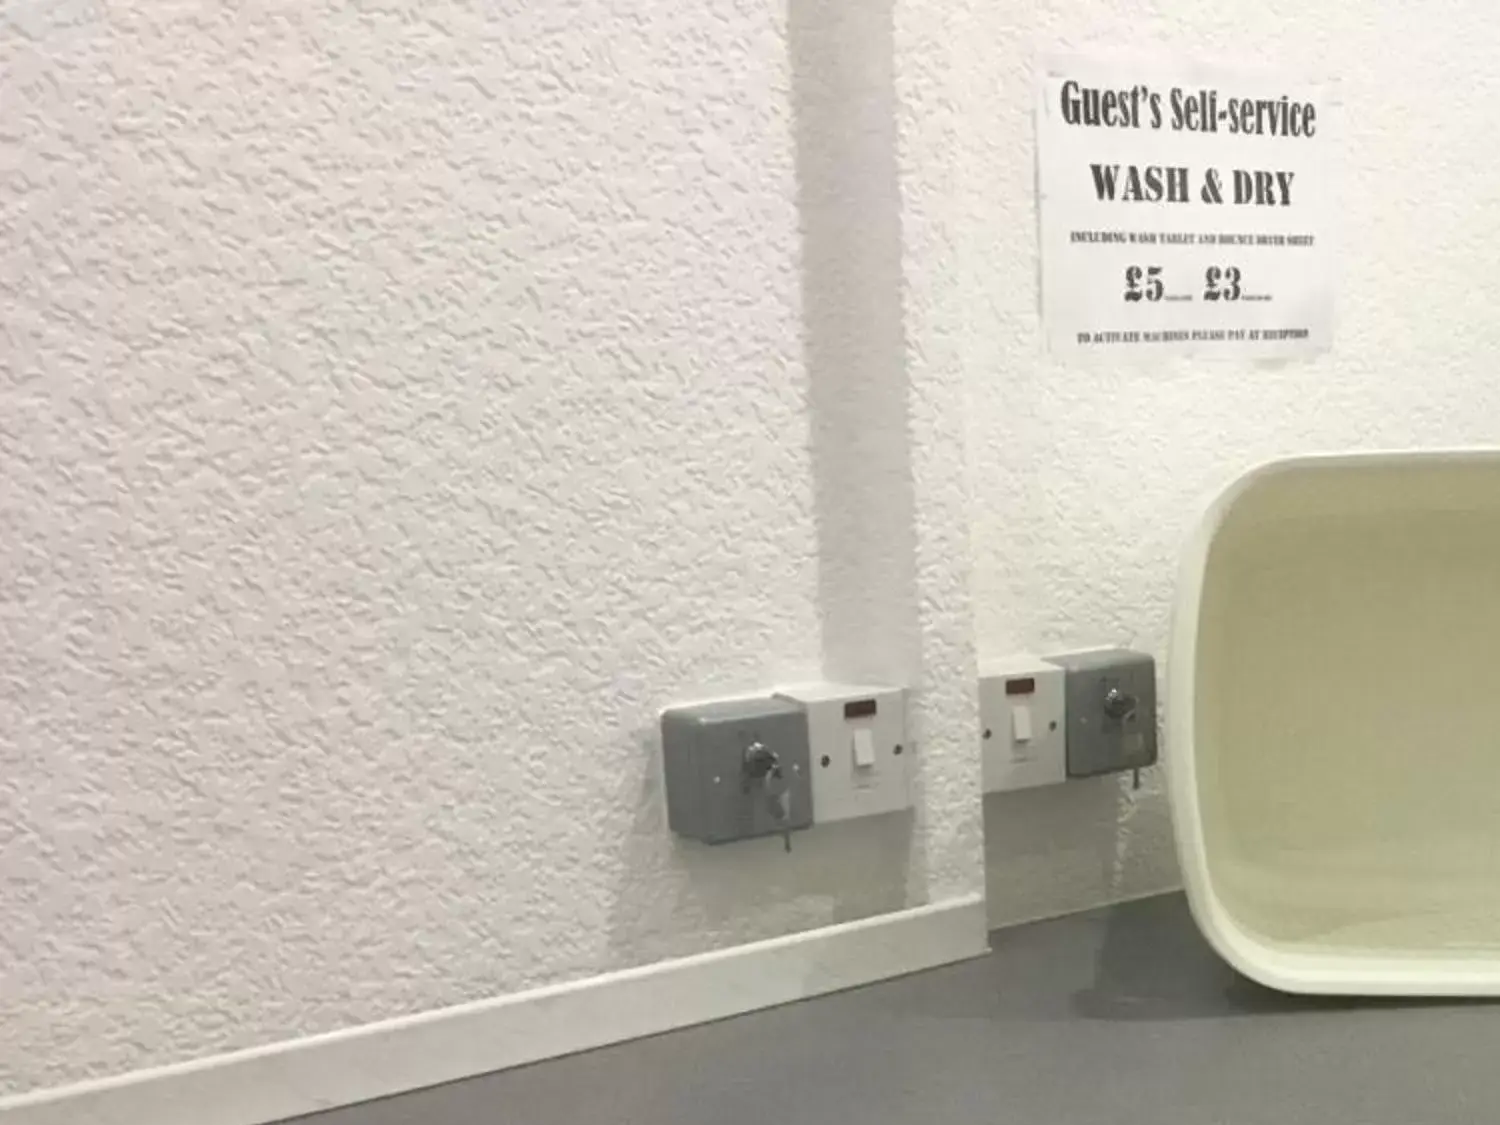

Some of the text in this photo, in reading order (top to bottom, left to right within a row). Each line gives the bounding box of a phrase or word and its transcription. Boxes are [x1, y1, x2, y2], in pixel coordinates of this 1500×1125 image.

[1060, 79, 1316, 137] Guest's Self-service
[1090, 164, 1295, 206] WASH & DRY
[1071, 231, 1126, 243] INCLUDING
[1124, 265, 1241, 302] £5 £3
